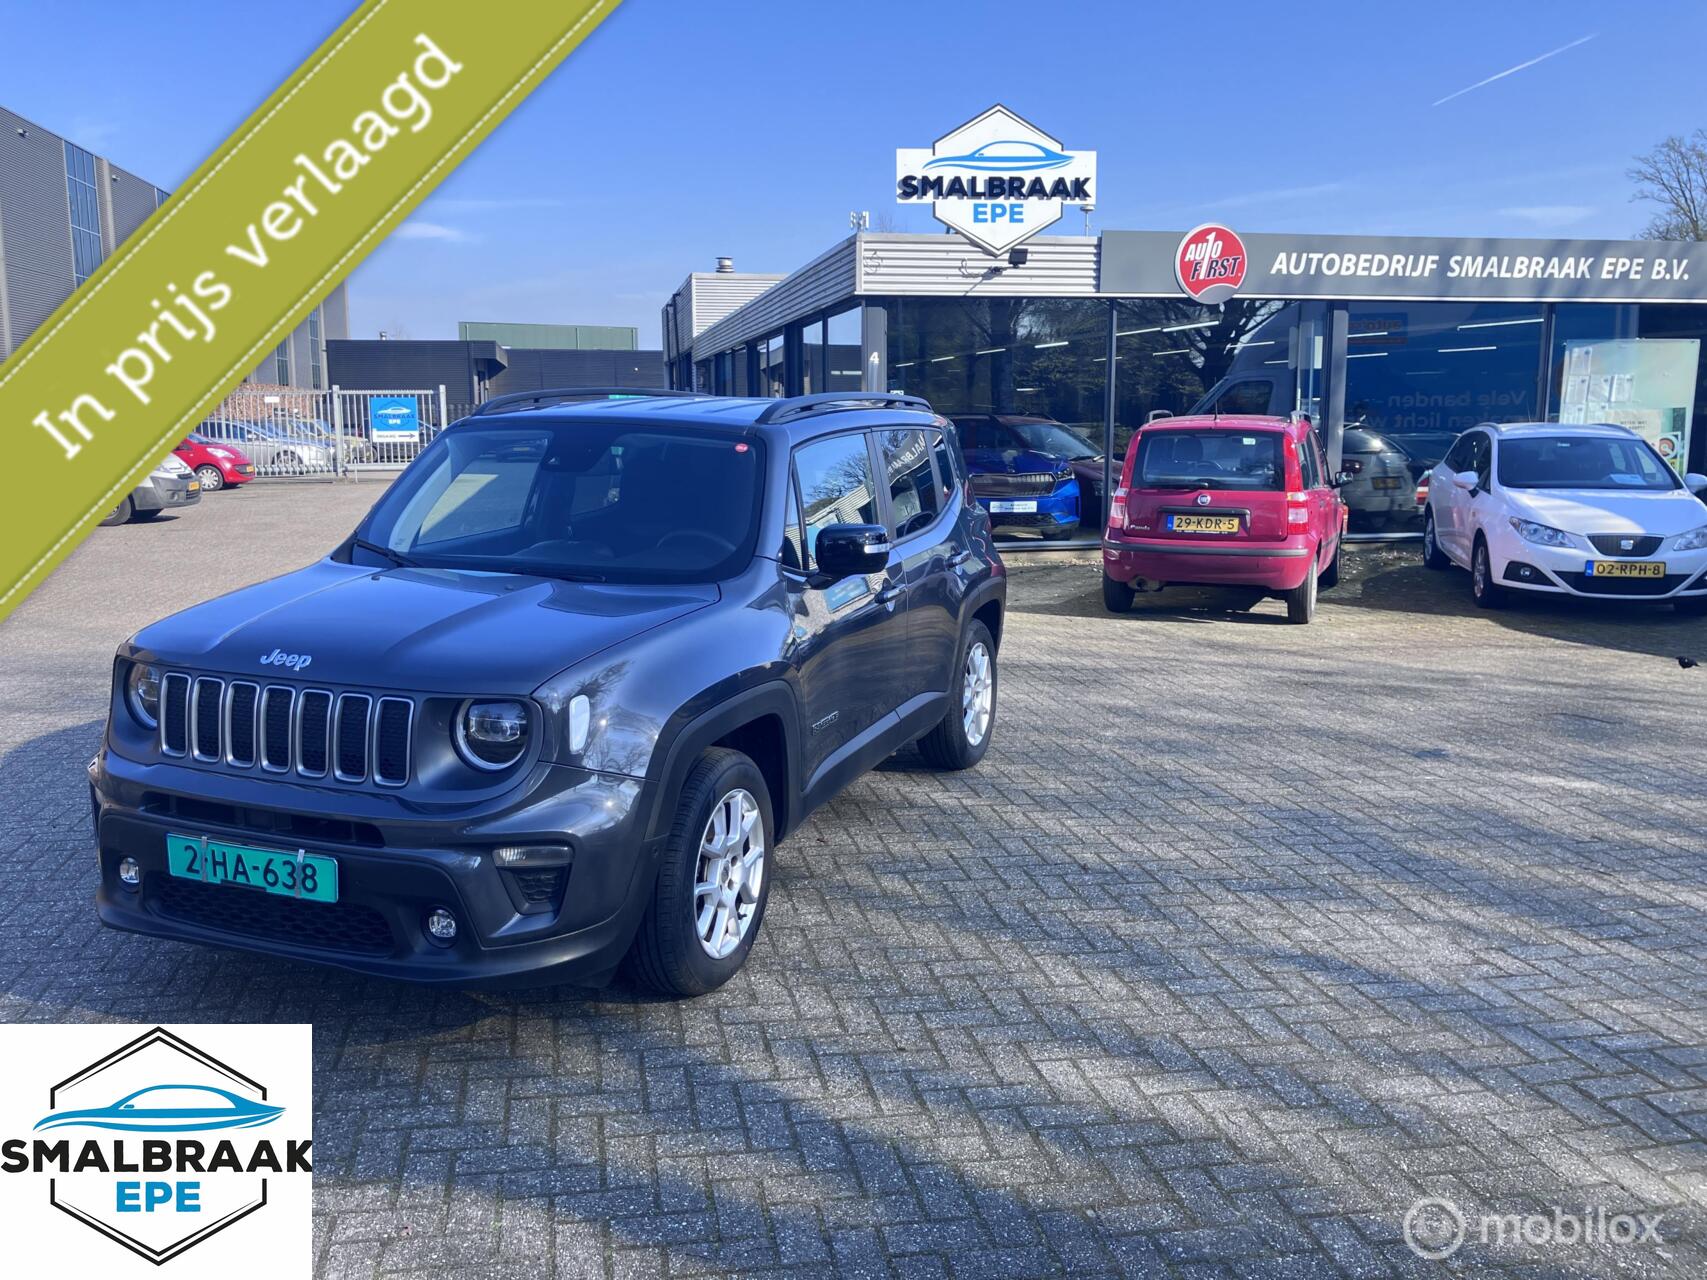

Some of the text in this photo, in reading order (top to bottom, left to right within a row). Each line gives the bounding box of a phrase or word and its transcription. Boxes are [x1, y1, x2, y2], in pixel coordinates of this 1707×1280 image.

[897, 174, 1092, 200] SMALBRAAK
[973, 203, 1024, 223] EPE
[1270, 252, 1690, 281] AUTOBEDRIJF SMALBRAAK EPE B.V.
[869, 351, 880, 364] 4
[1176, 517, 1235, 530] 29-KDR-5
[1596, 563, 1661, 576] 02-RPH-8
[260, 649, 312, 671] Jeep
